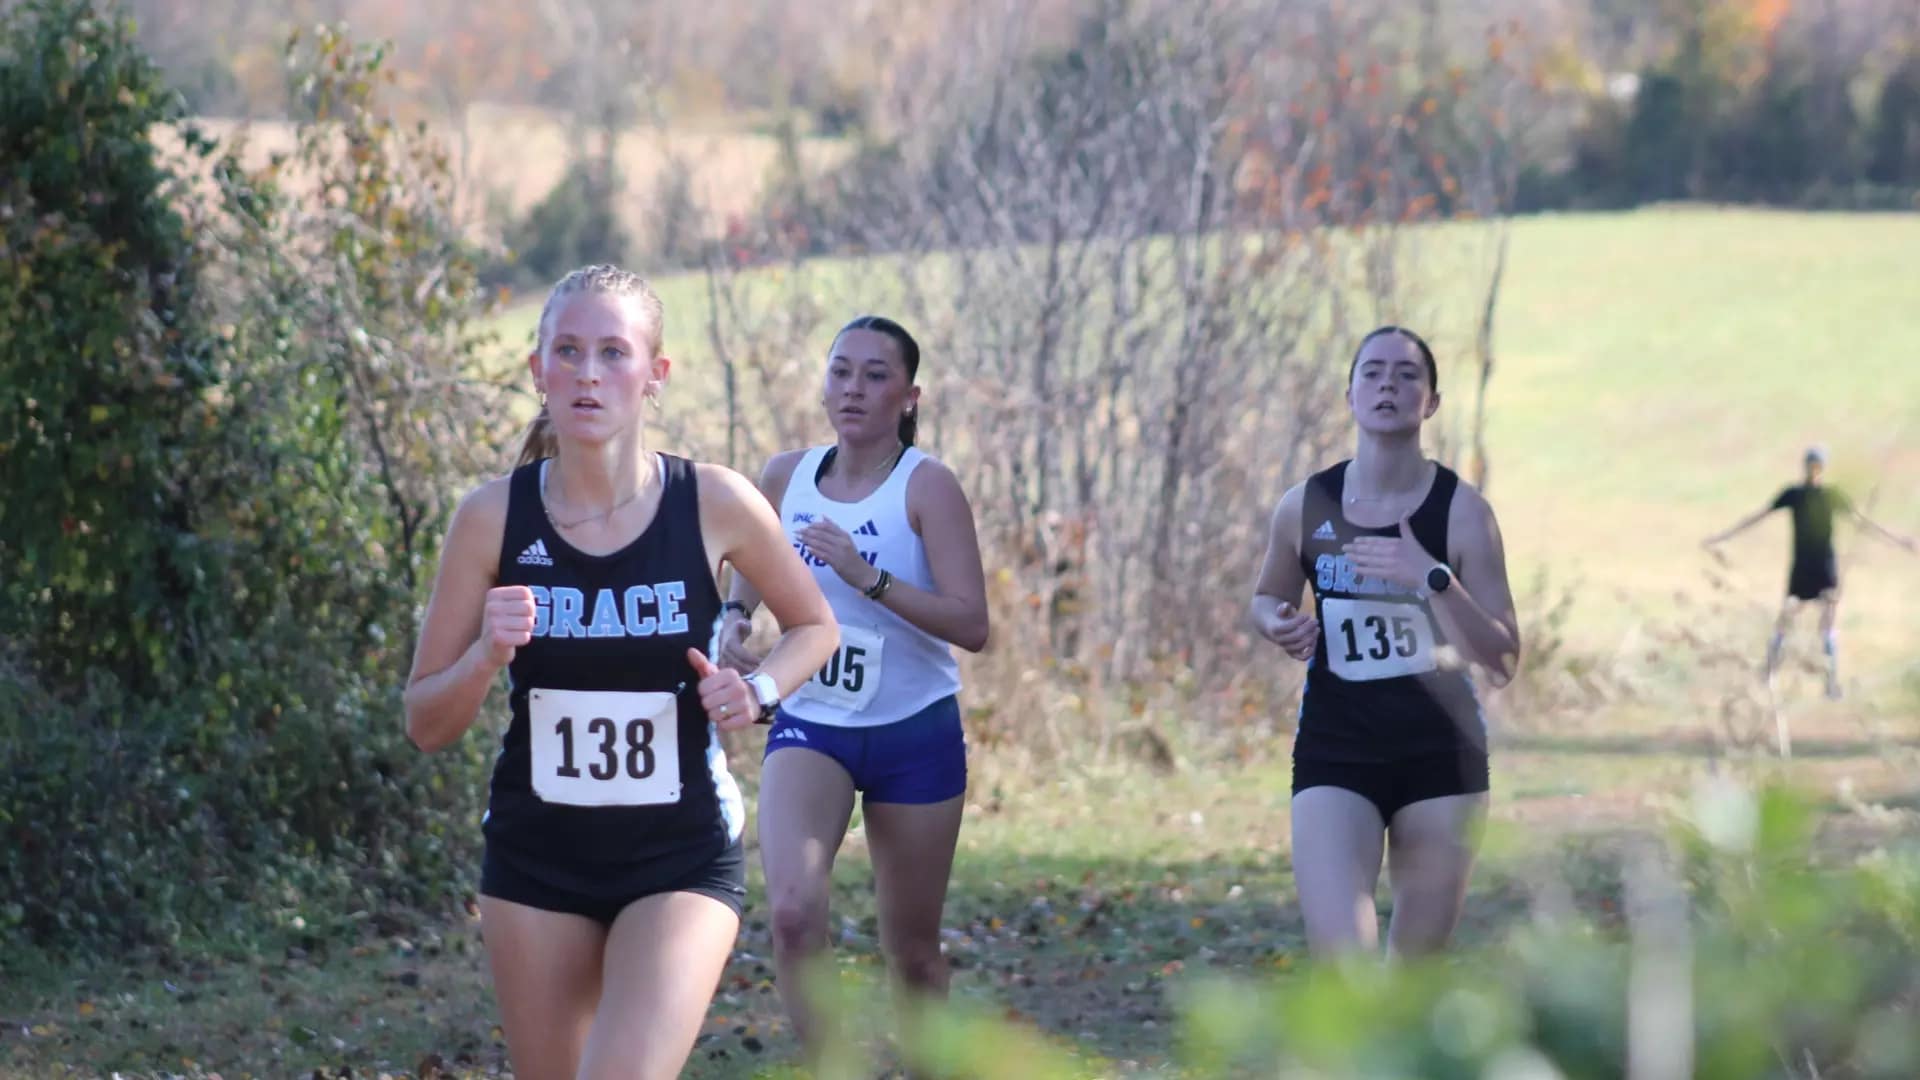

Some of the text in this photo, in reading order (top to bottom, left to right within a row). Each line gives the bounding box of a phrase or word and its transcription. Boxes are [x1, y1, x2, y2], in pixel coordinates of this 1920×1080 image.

[516, 555, 554, 566] adidas
[1340, 615, 1418, 662] 135
[808, 645, 867, 693] 05
[555, 716, 656, 781] 138
